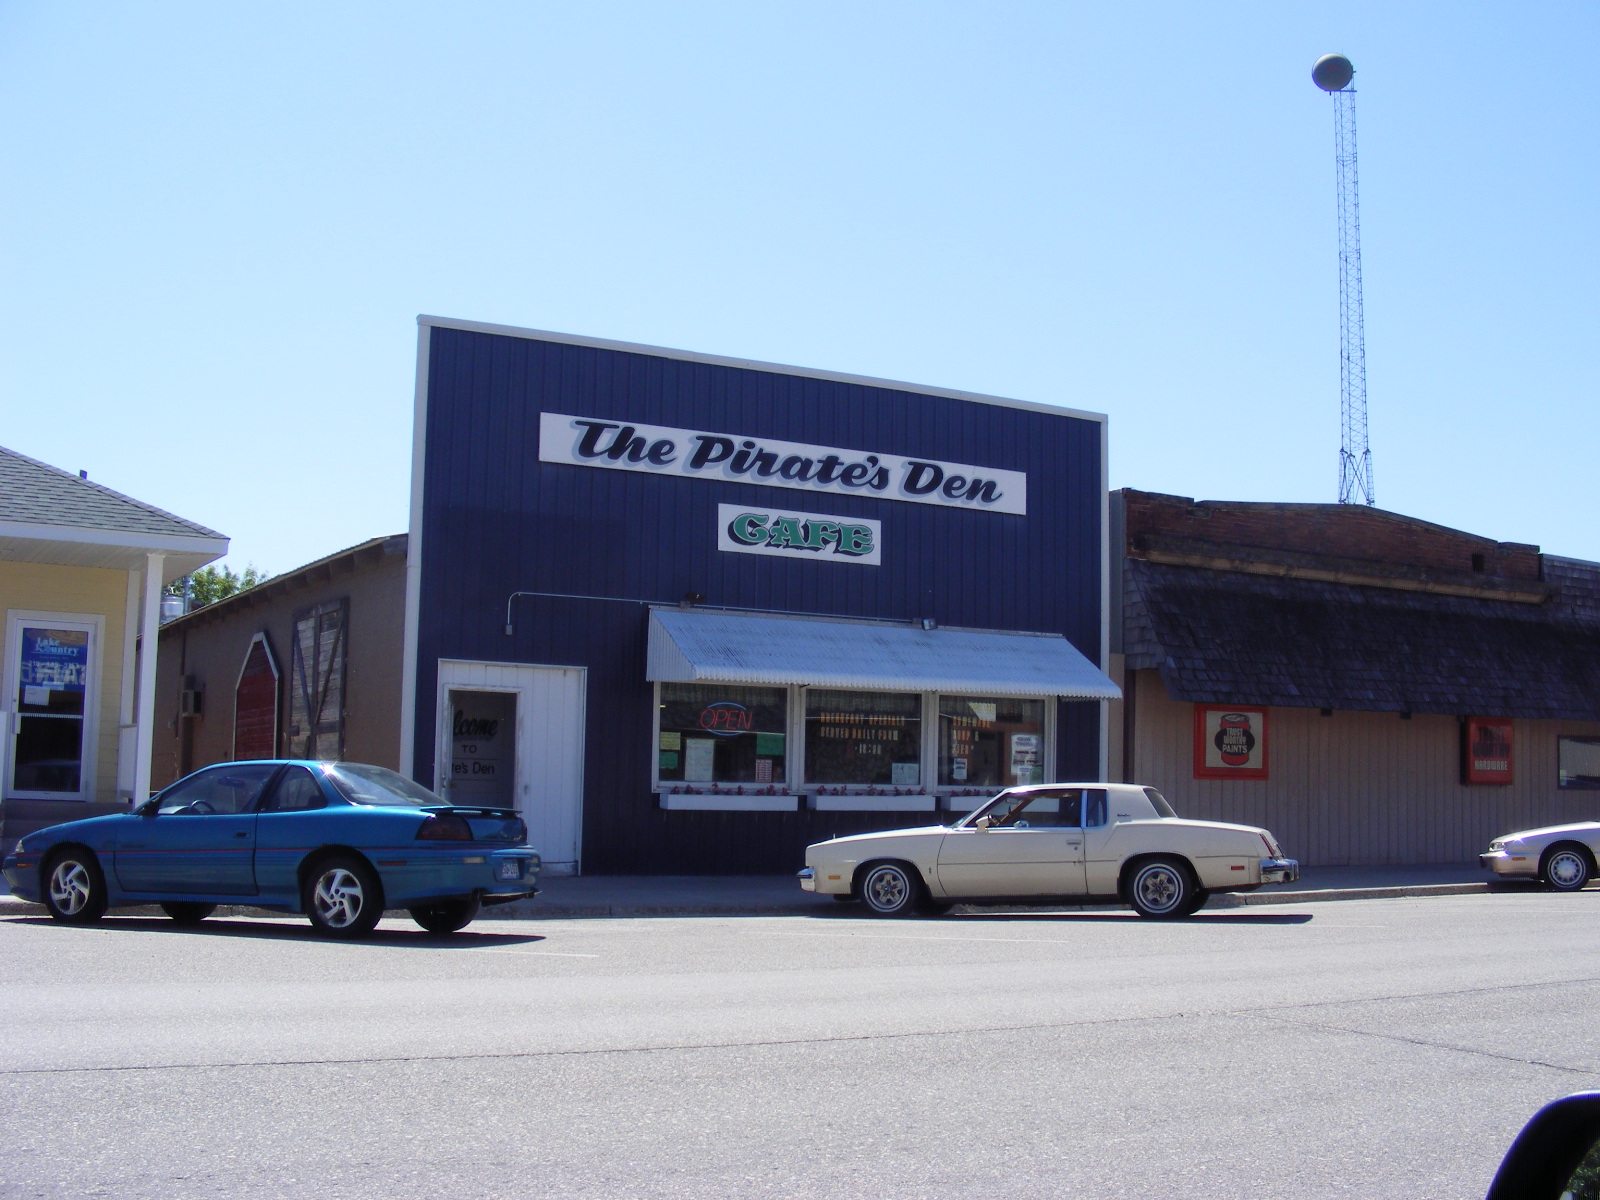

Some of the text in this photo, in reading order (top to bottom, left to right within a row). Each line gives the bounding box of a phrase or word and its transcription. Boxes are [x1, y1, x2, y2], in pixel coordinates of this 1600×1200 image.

[574, 418, 1003, 509] The Pirate's Den
[729, 512, 875, 556] CAFE
[37, 636, 61, 647] Lake
[700, 708, 753, 730] OPEN
[851, 728, 876, 740] DAILY
[462, 744, 478, 754] TO
[1222, 744, 1248, 754] PAINTS
[472, 761, 495, 775] Den
[1474, 760, 1508, 771] HARDWARE
